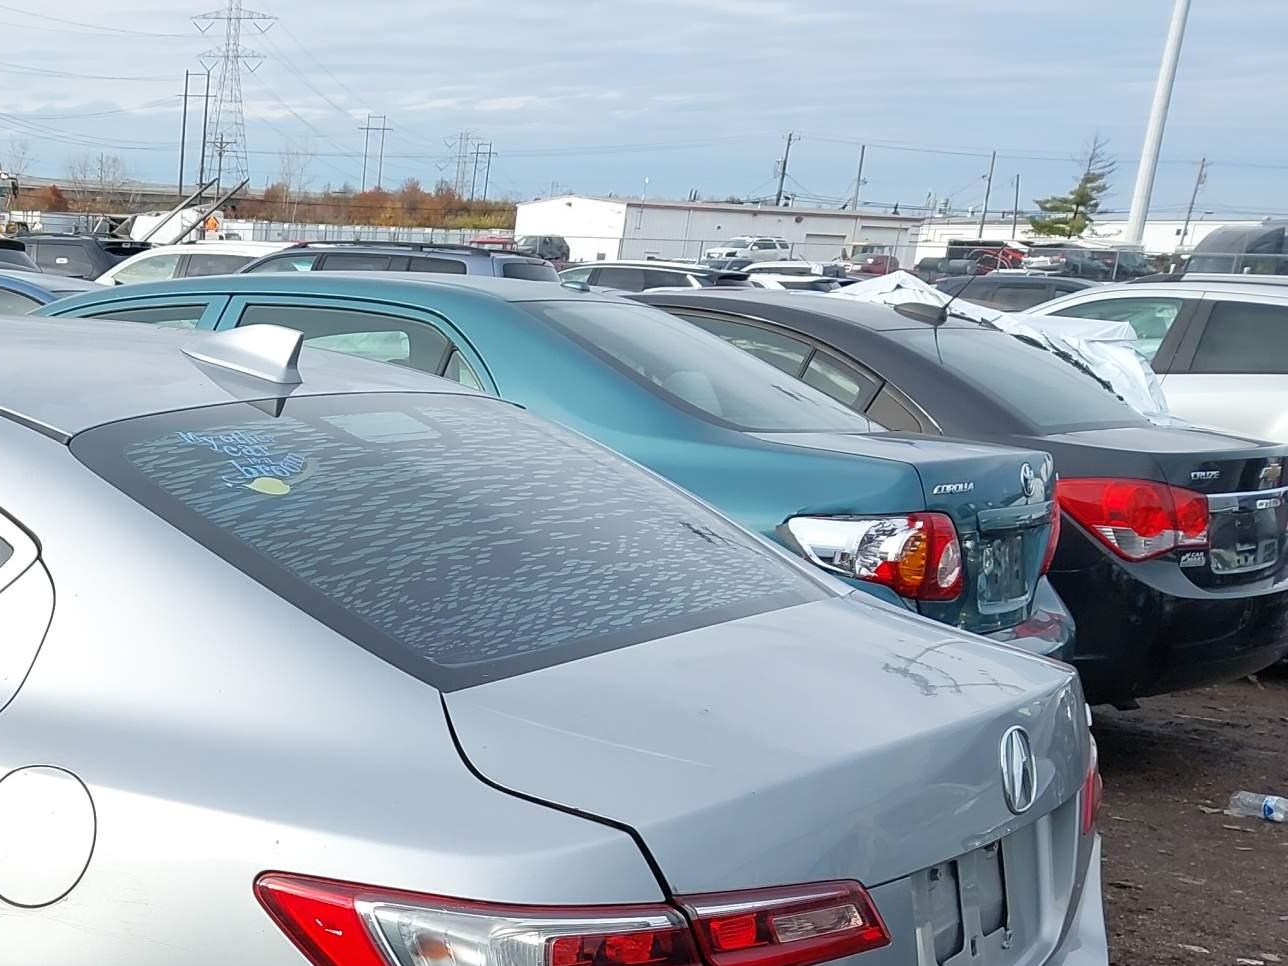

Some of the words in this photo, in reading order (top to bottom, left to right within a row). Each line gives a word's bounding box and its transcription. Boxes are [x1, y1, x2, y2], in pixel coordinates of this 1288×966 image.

[175, 431, 218, 451] My
[219, 430, 275, 445] other
[223, 444, 270, 457] car
[227, 453, 305, 479] broom
[1191, 470, 1221, 480] CRUZE
[933, 481, 975, 495] COROLLA
